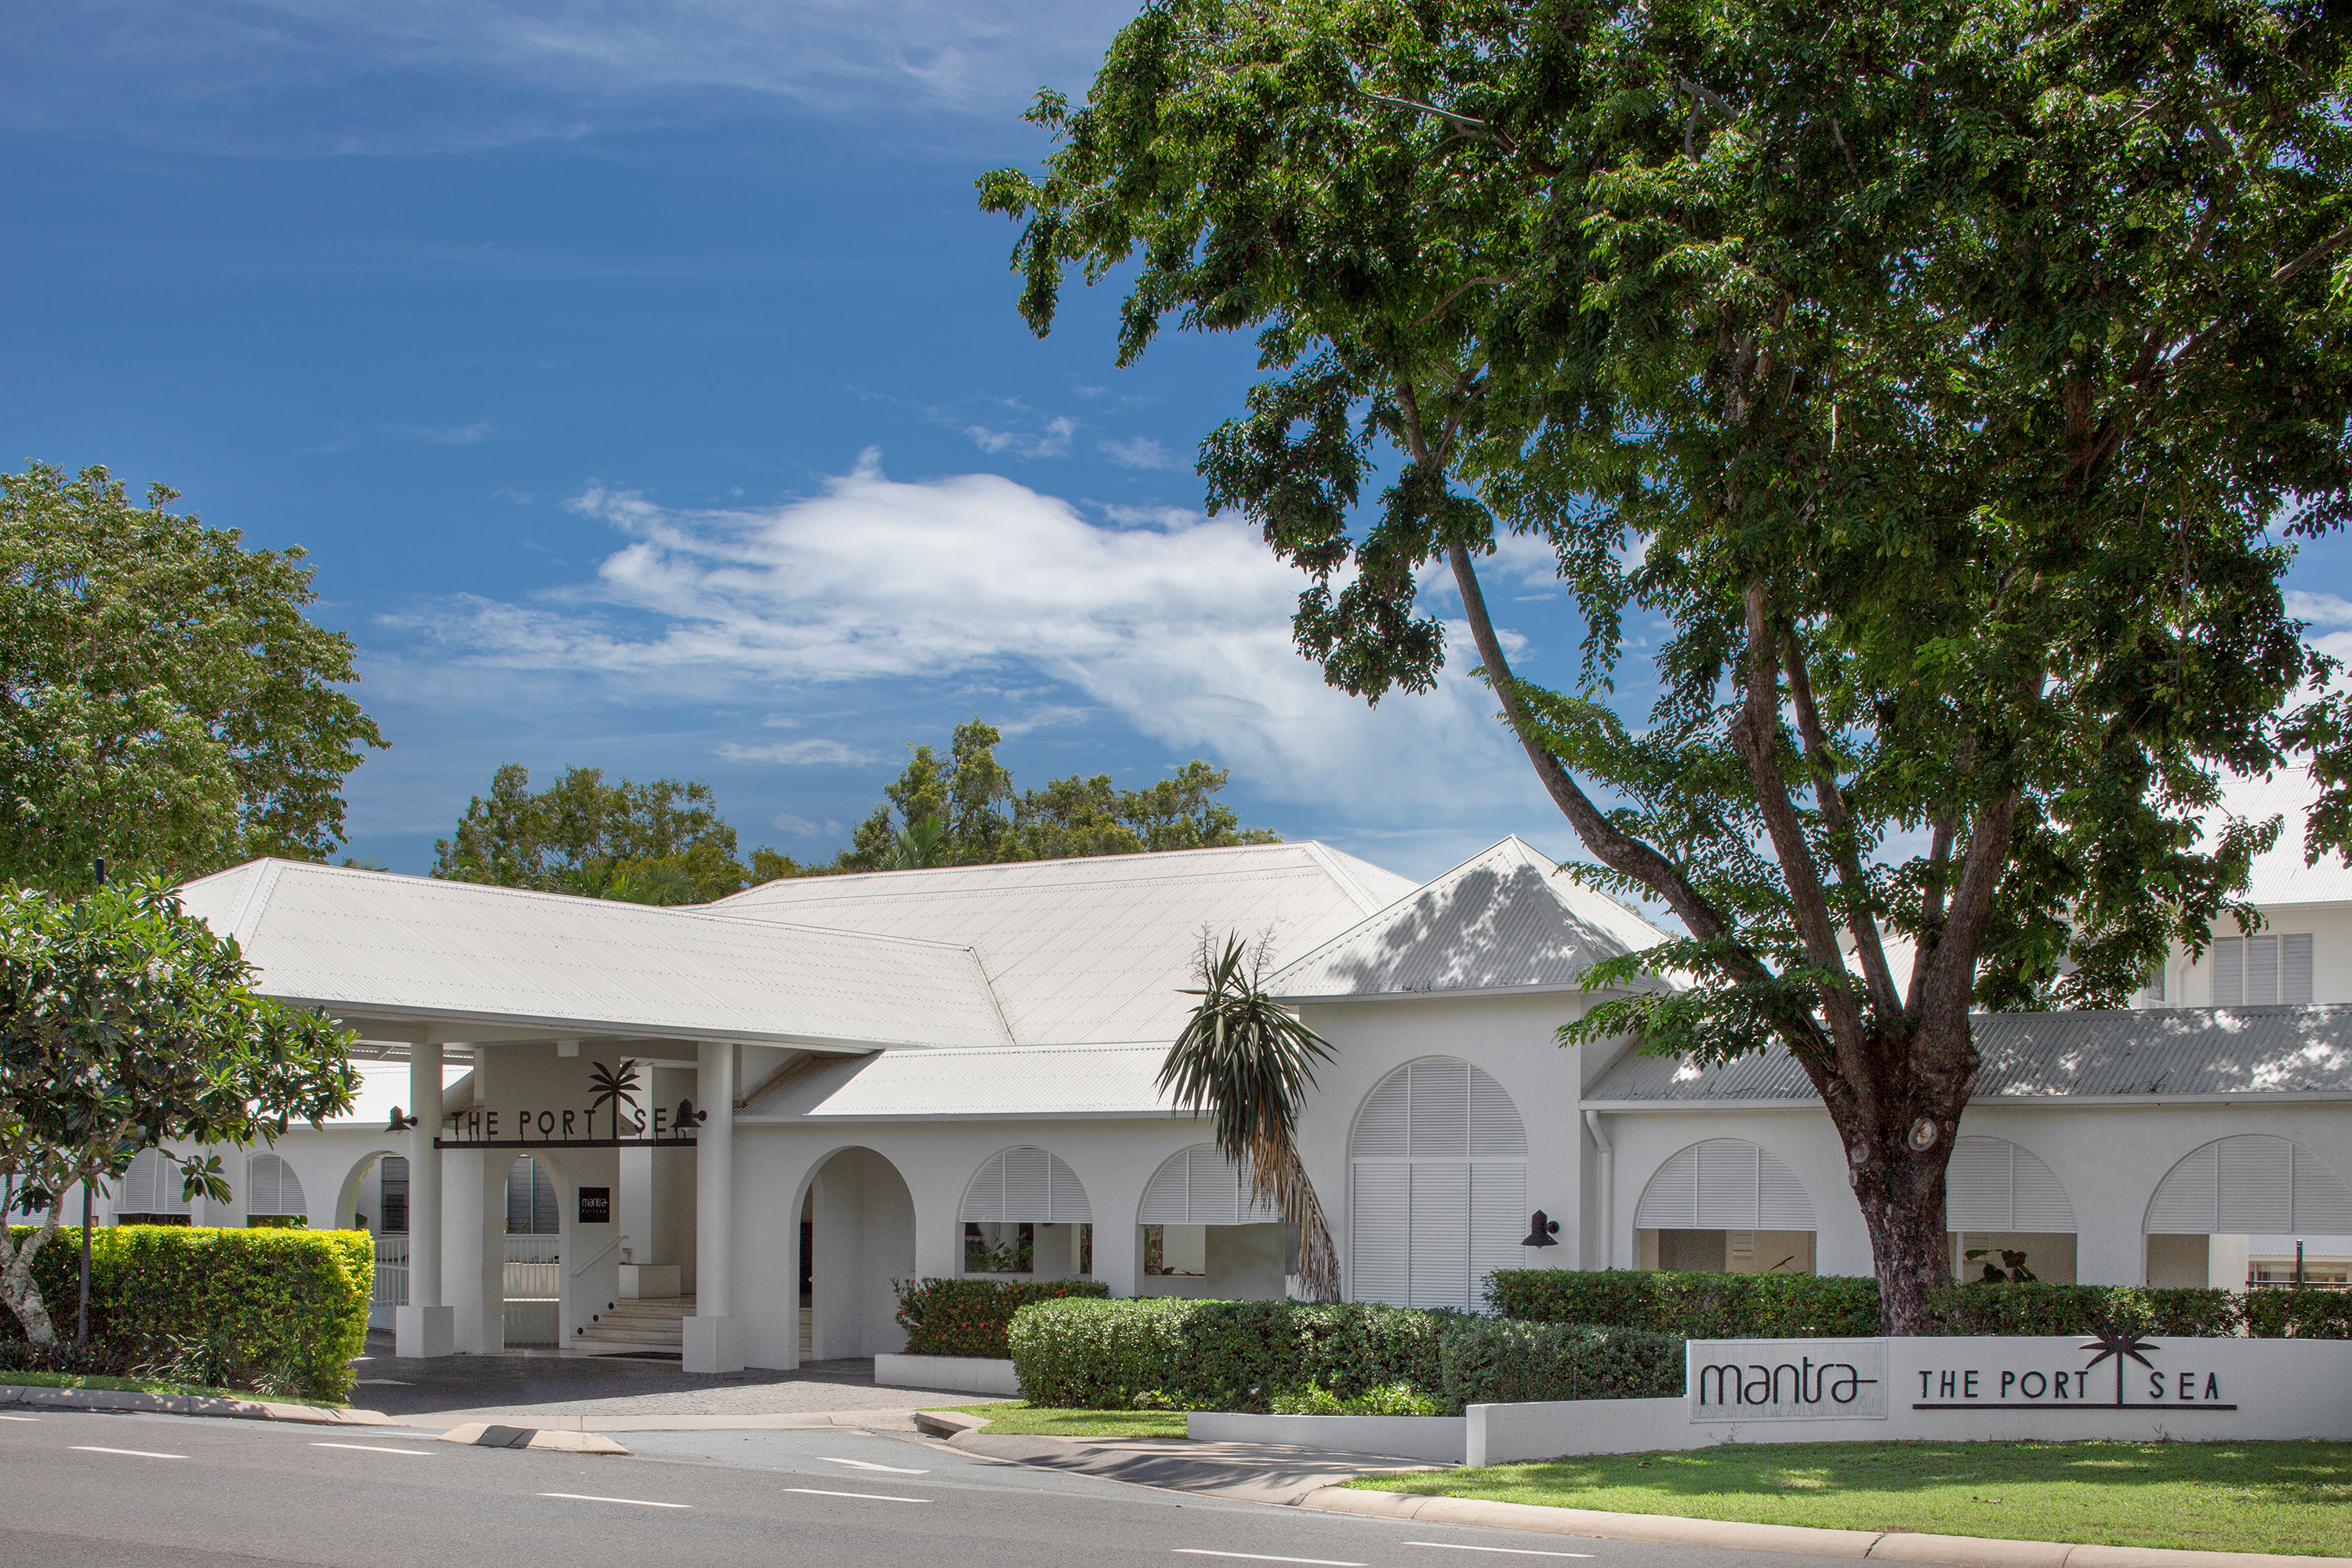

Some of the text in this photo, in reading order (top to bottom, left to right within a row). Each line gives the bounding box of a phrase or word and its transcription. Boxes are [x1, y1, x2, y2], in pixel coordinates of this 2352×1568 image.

[452, 1108, 687, 1135] THE PORT SE
[582, 1197, 608, 1207] mantra
[1700, 1356, 1878, 1405] mantra
[1918, 1370, 2219, 1399] THE PORT SEA
